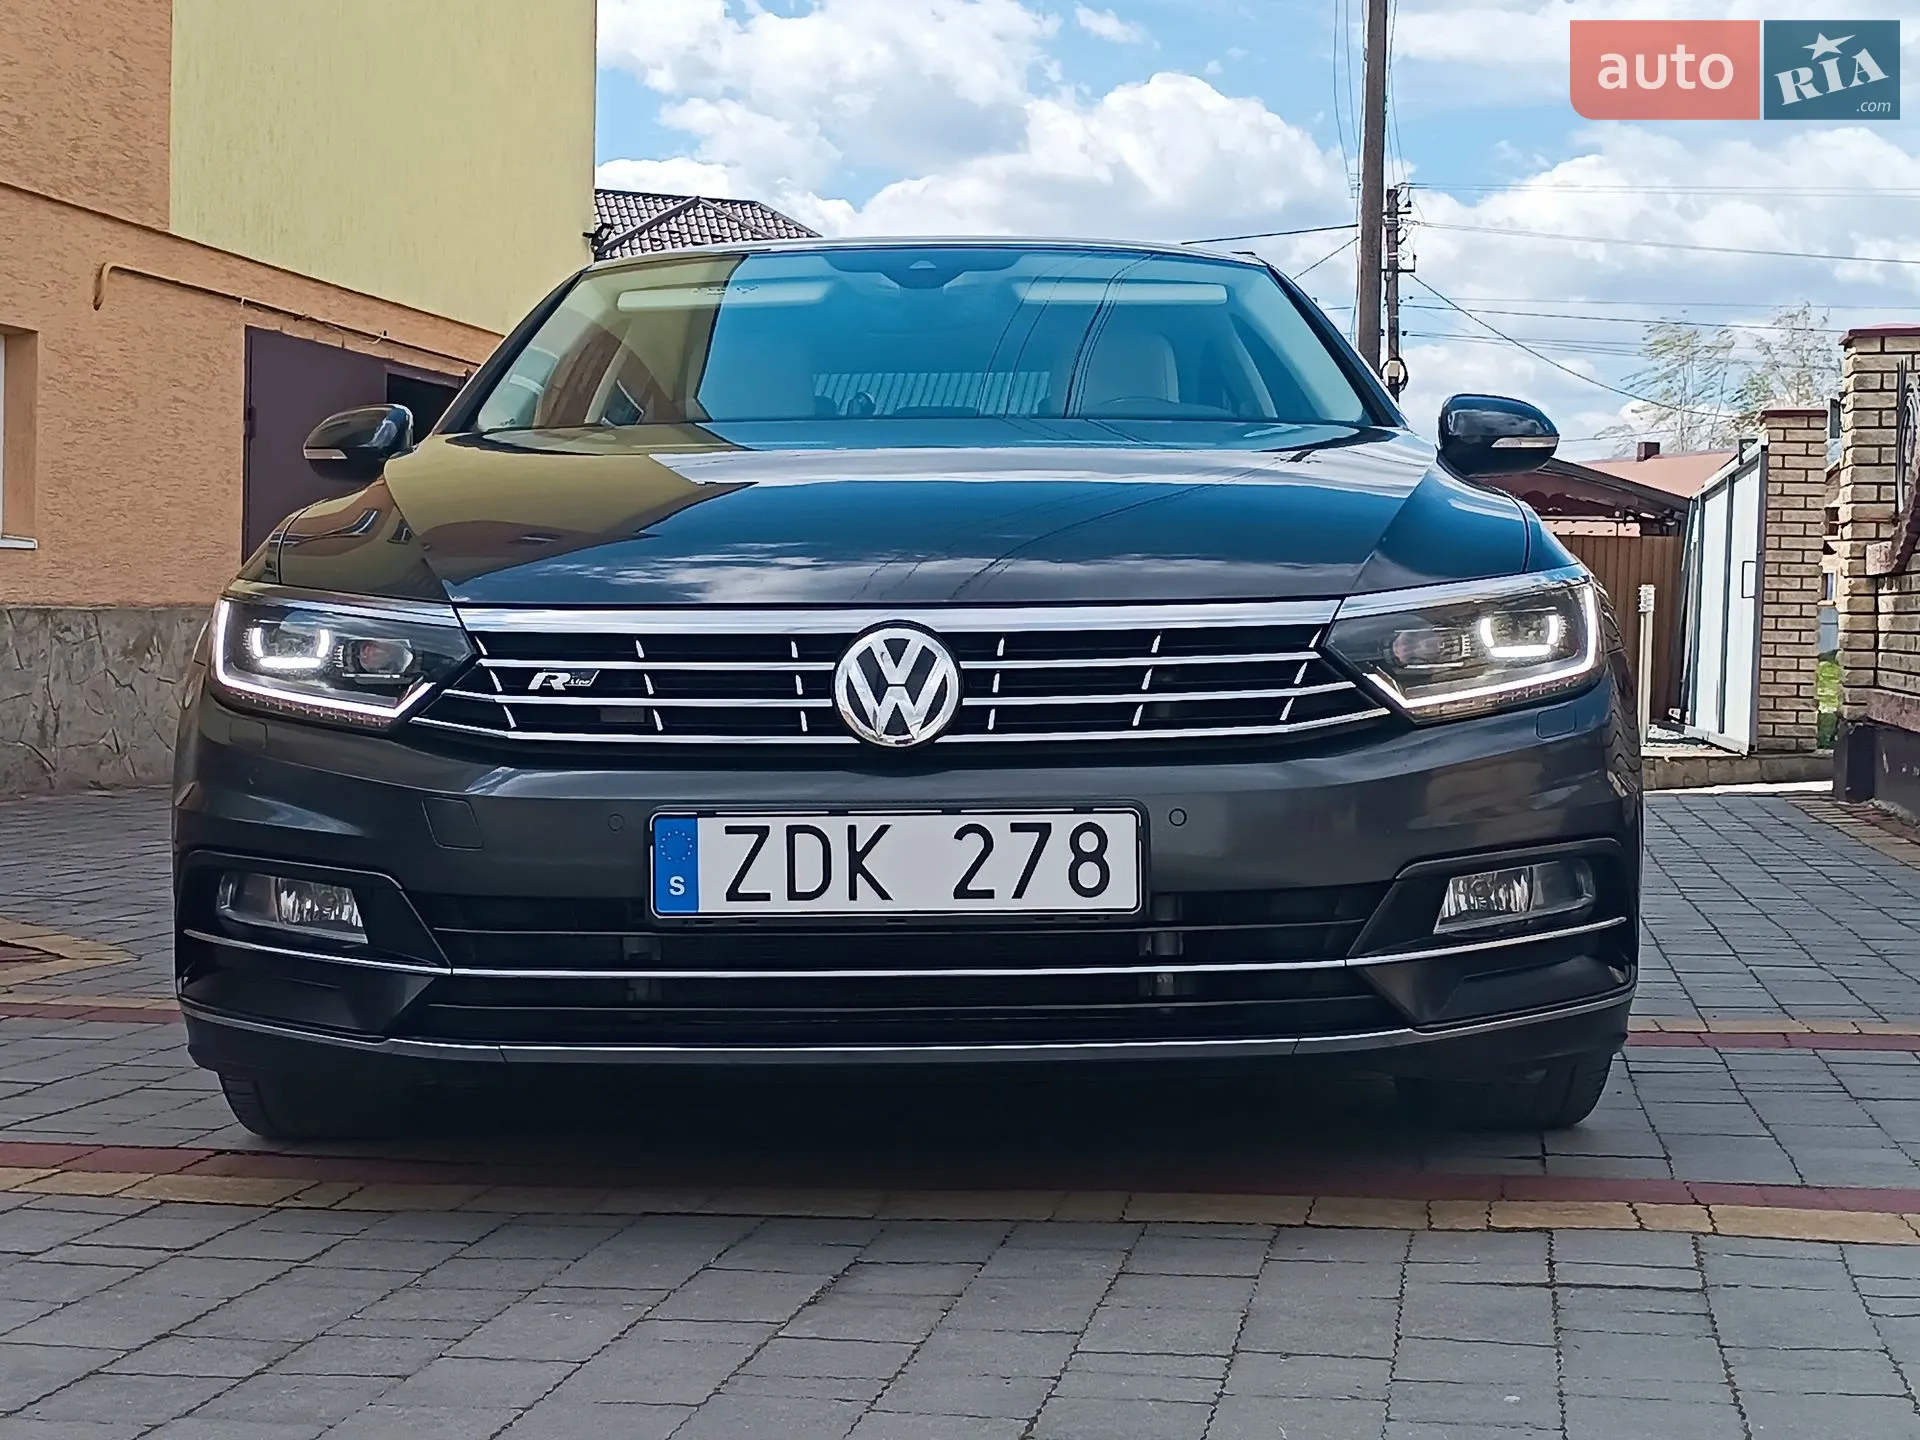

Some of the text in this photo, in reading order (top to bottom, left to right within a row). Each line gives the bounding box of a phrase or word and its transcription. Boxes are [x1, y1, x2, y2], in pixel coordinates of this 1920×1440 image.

[669, 875, 685, 896] S
[724, 821, 1111, 902] ZDK 278
